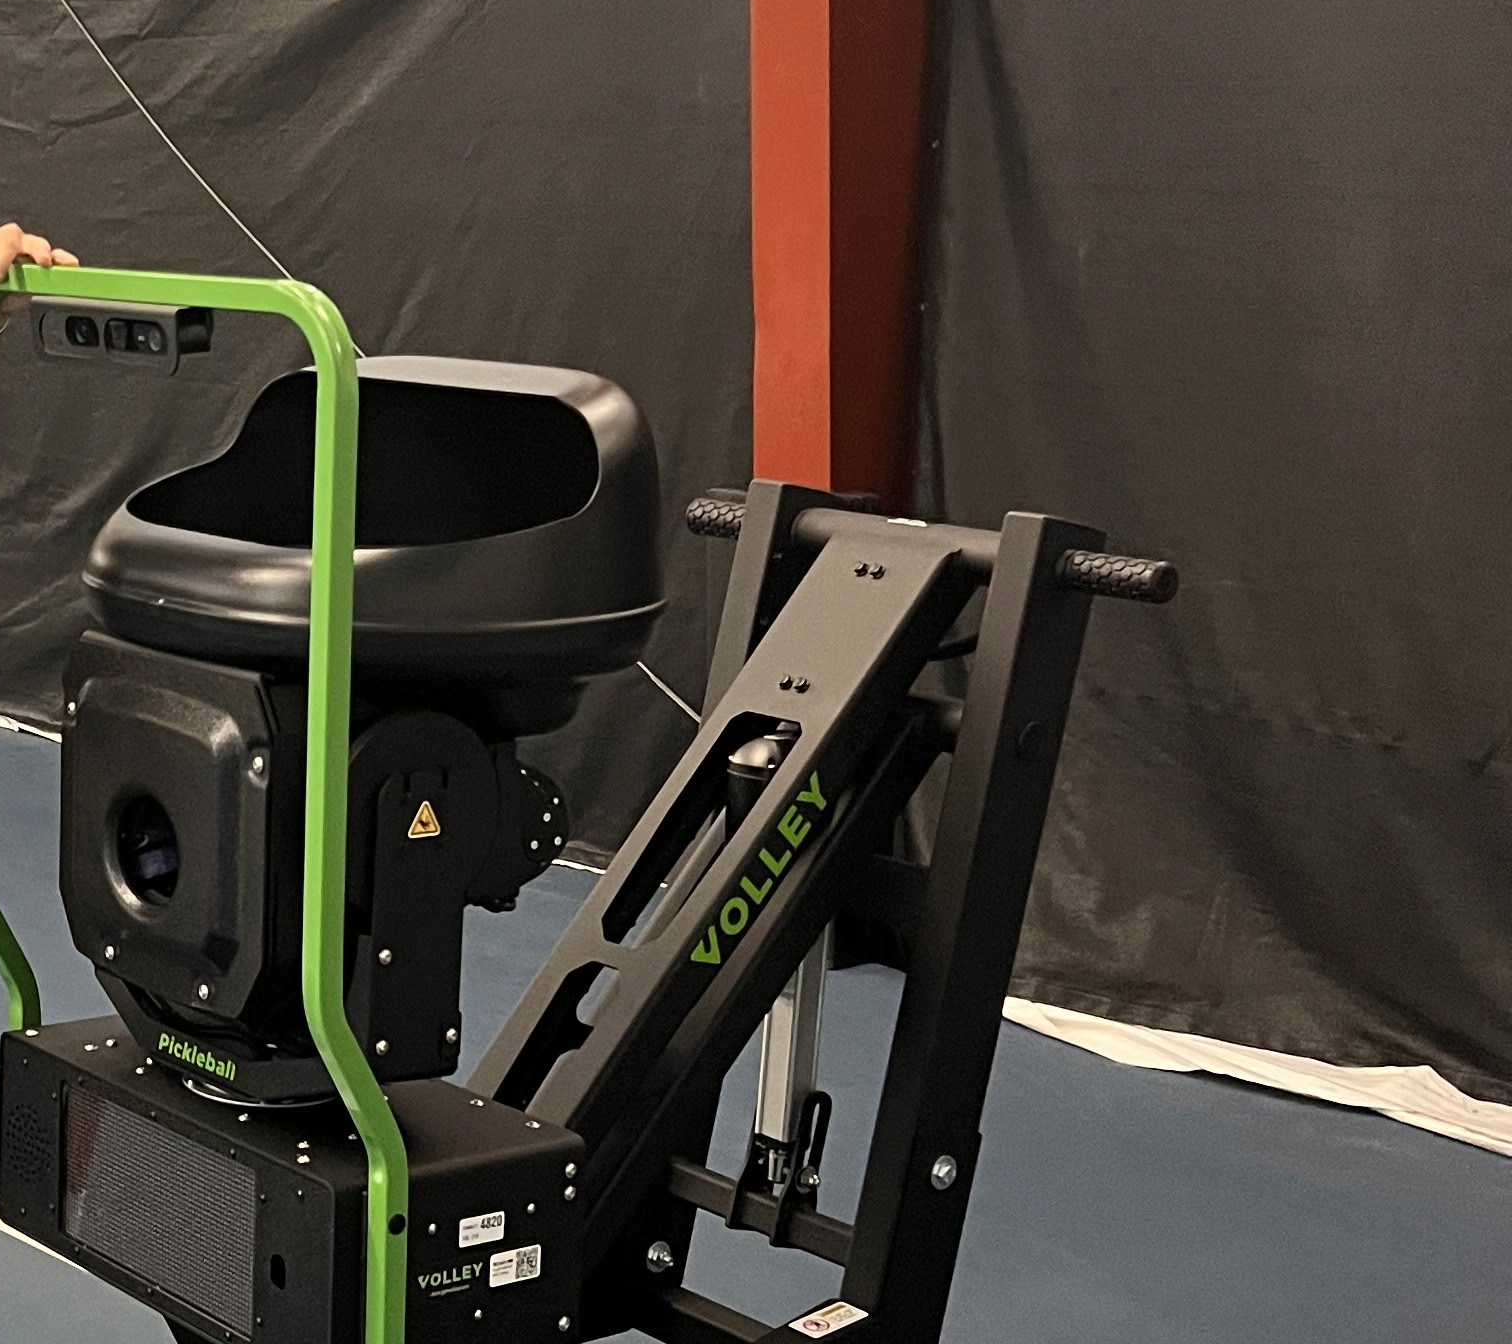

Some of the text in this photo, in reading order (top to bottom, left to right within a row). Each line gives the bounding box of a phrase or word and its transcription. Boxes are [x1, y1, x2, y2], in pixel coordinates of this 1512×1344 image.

[690, 770, 827, 964] VOLLEY
[158, 1032, 236, 1081] Pickleball
[417, 1262, 483, 1290] VOLLEY
